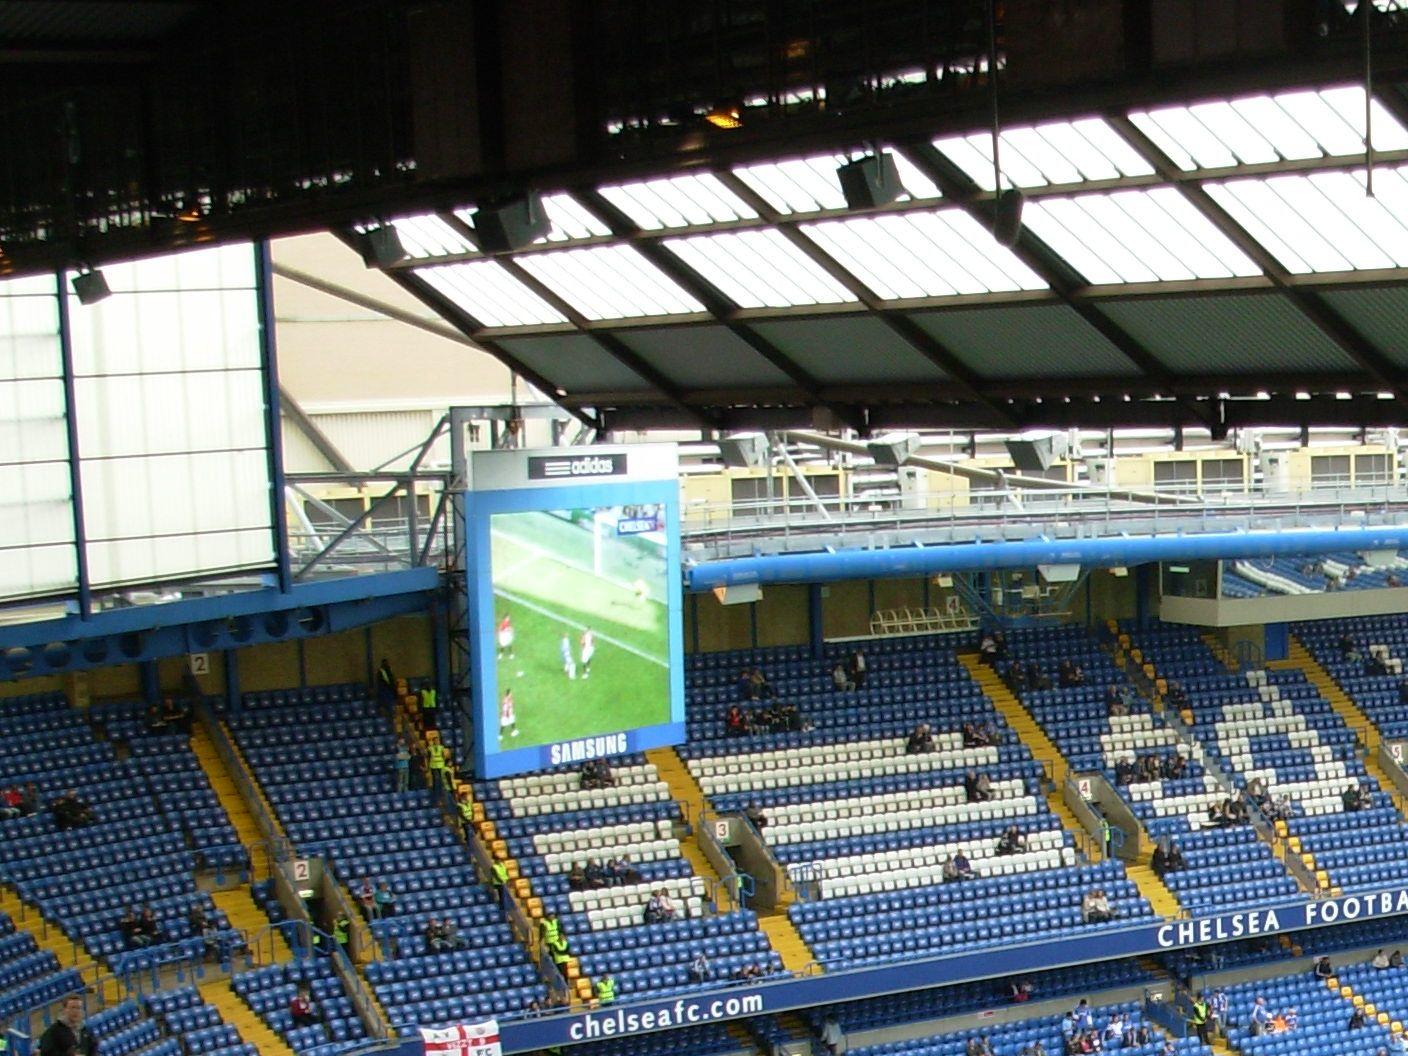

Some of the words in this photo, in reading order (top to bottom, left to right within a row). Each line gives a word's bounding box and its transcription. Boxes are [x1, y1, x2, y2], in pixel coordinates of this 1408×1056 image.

[572, 457, 614, 474] adidas
[195, 656, 206, 671] 2
[551, 733, 627, 765] SAMSUNG
[296, 863, 308, 877] 2
[1158, 909, 1280, 948] CHELSEA
[570, 994, 763, 1040] chelseafc.com
